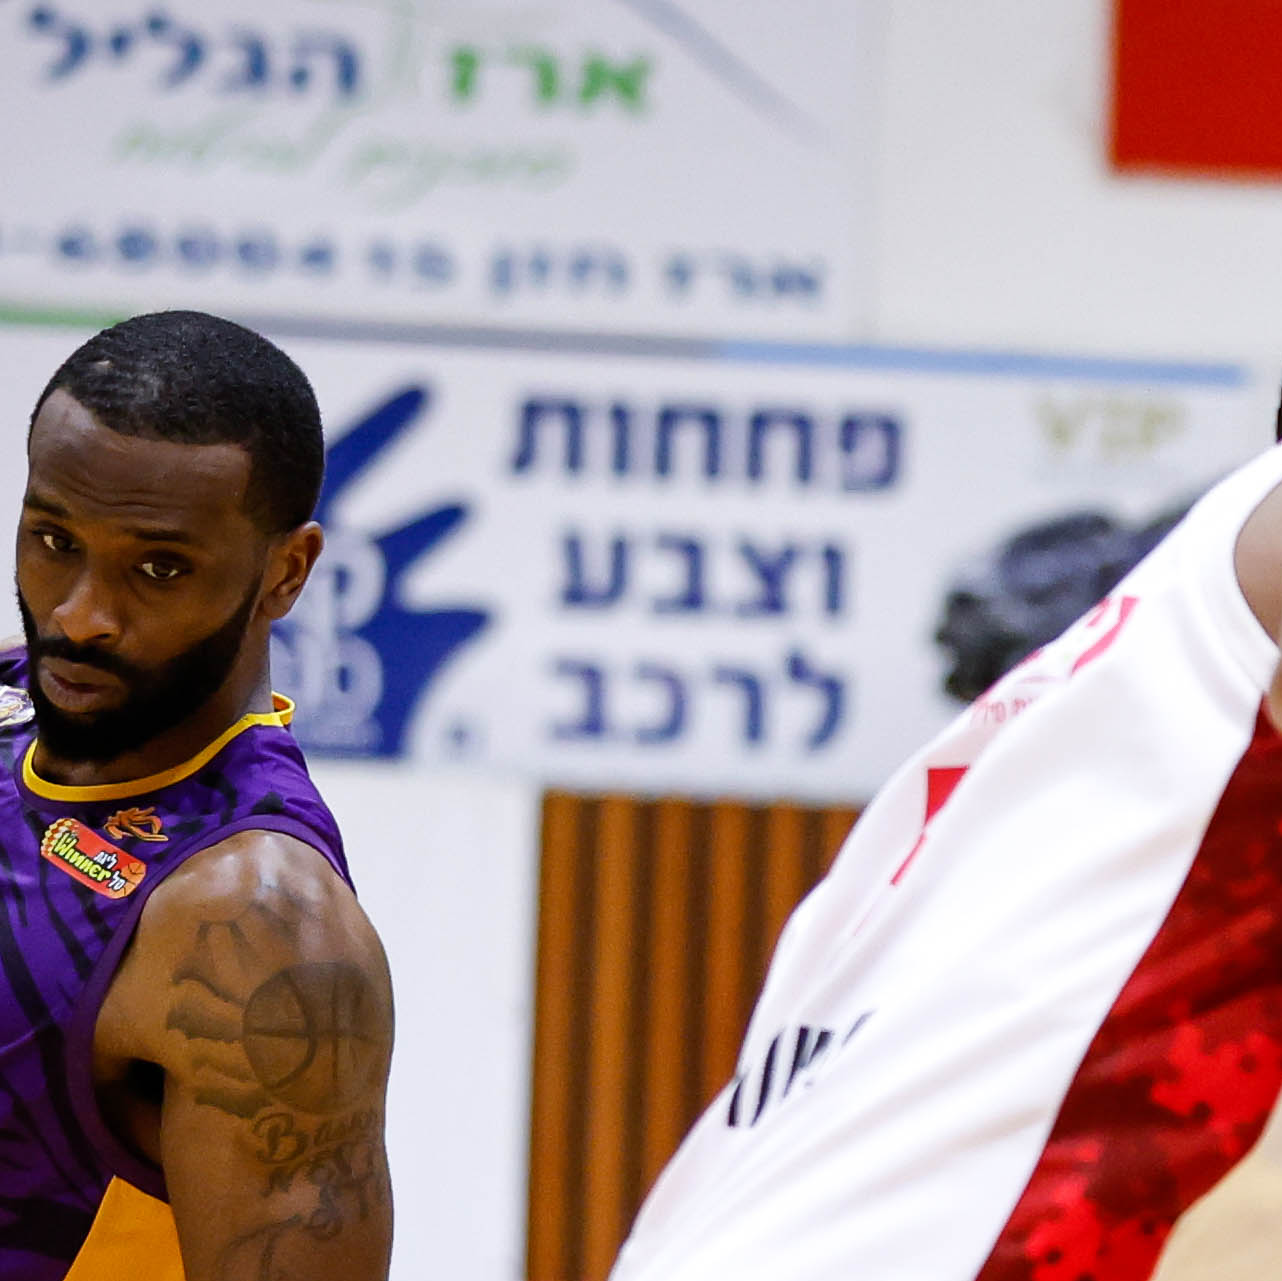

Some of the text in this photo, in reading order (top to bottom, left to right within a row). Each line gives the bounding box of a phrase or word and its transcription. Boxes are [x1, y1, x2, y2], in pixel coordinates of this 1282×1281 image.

[27, 4, 654, 112] ארז הגליל
[511, 394, 903, 494] פחחות
[559, 528, 846, 617] וצבע
[550, 647, 848, 752] לרכב
[53, 832, 112, 881] Winner
